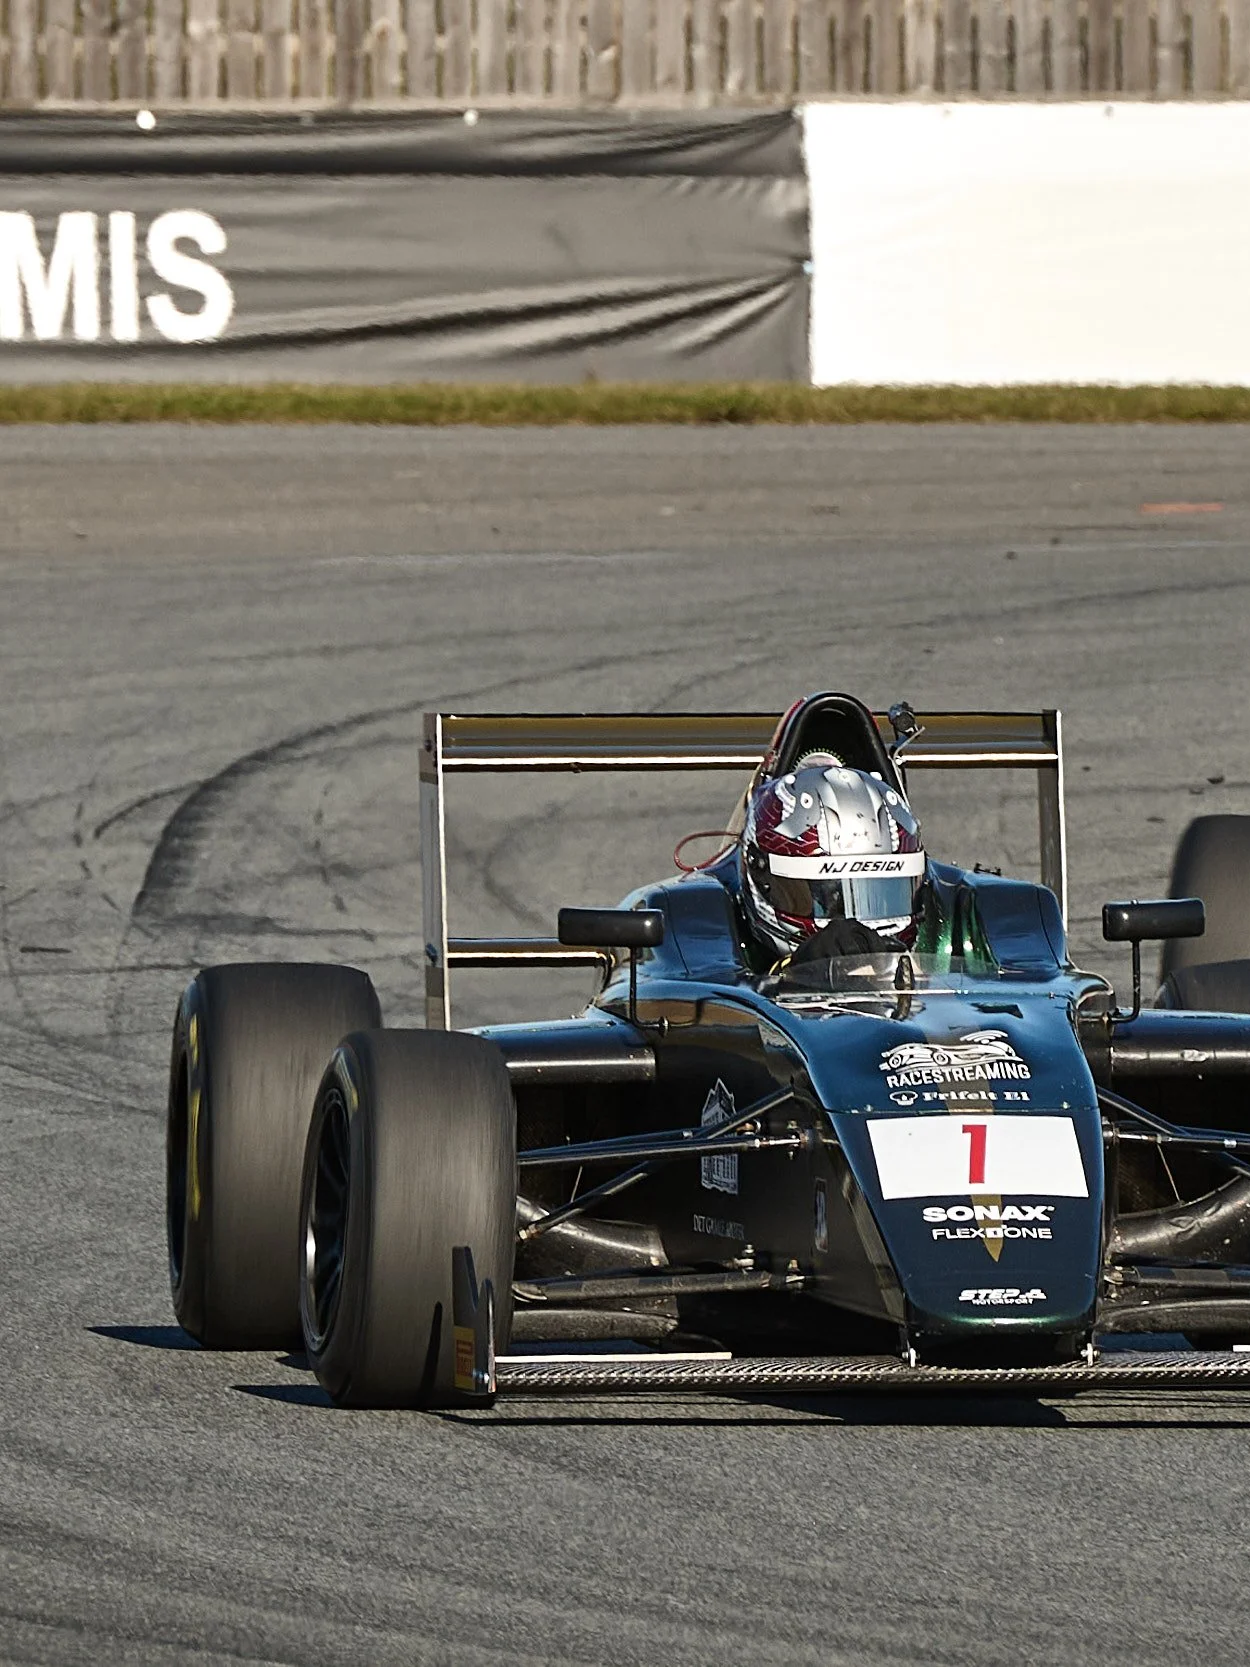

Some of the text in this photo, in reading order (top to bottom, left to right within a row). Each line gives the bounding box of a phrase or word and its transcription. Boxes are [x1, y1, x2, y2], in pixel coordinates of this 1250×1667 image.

[0, 209, 235, 344] MIS
[819, 860, 904, 874] NJ DESIGN
[886, 1062, 1031, 1088] RACESTREAMING
[962, 1124, 987, 1184] 1
[922, 1205, 1055, 1222] SONAX
